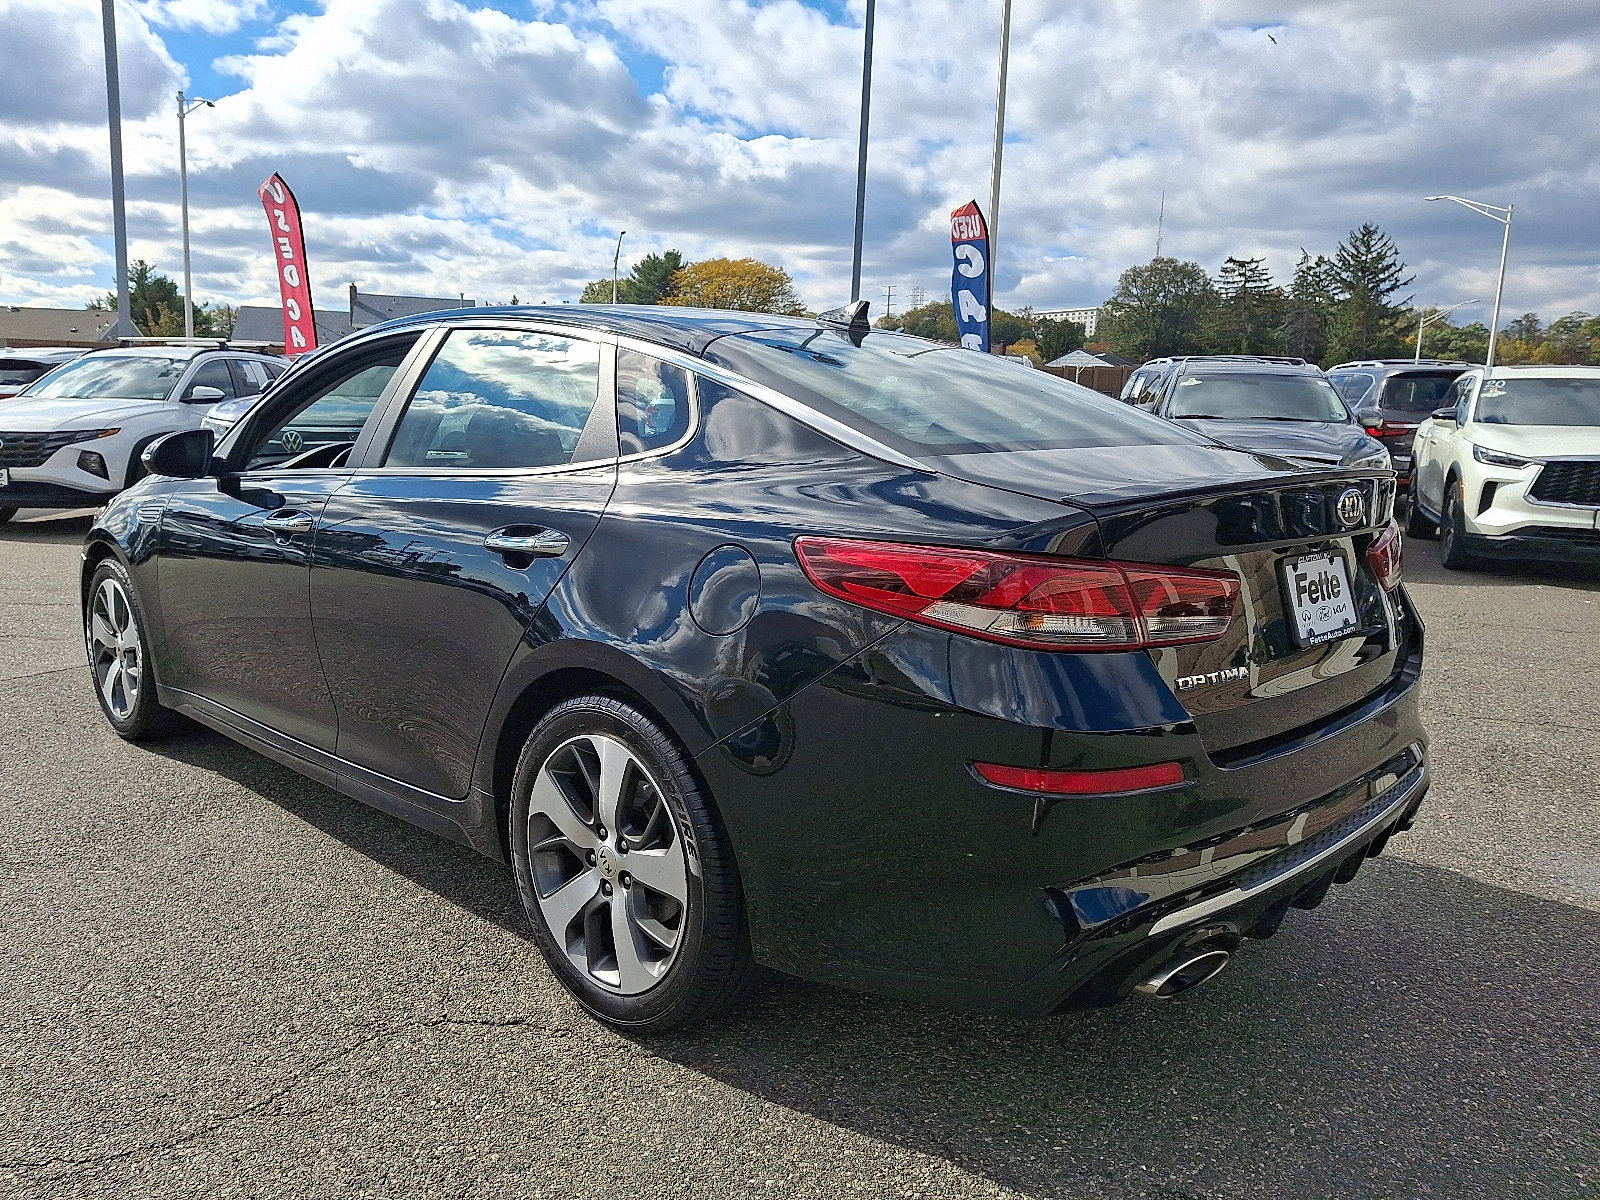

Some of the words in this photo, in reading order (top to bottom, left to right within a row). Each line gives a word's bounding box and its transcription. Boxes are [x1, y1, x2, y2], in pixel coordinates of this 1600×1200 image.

[1295, 571, 1341, 608] Fette
[1310, 626, 1356, 645] FetteAuto.com
[1176, 666, 1250, 691] OPTIMA
[599, 849, 613, 875] KIA
